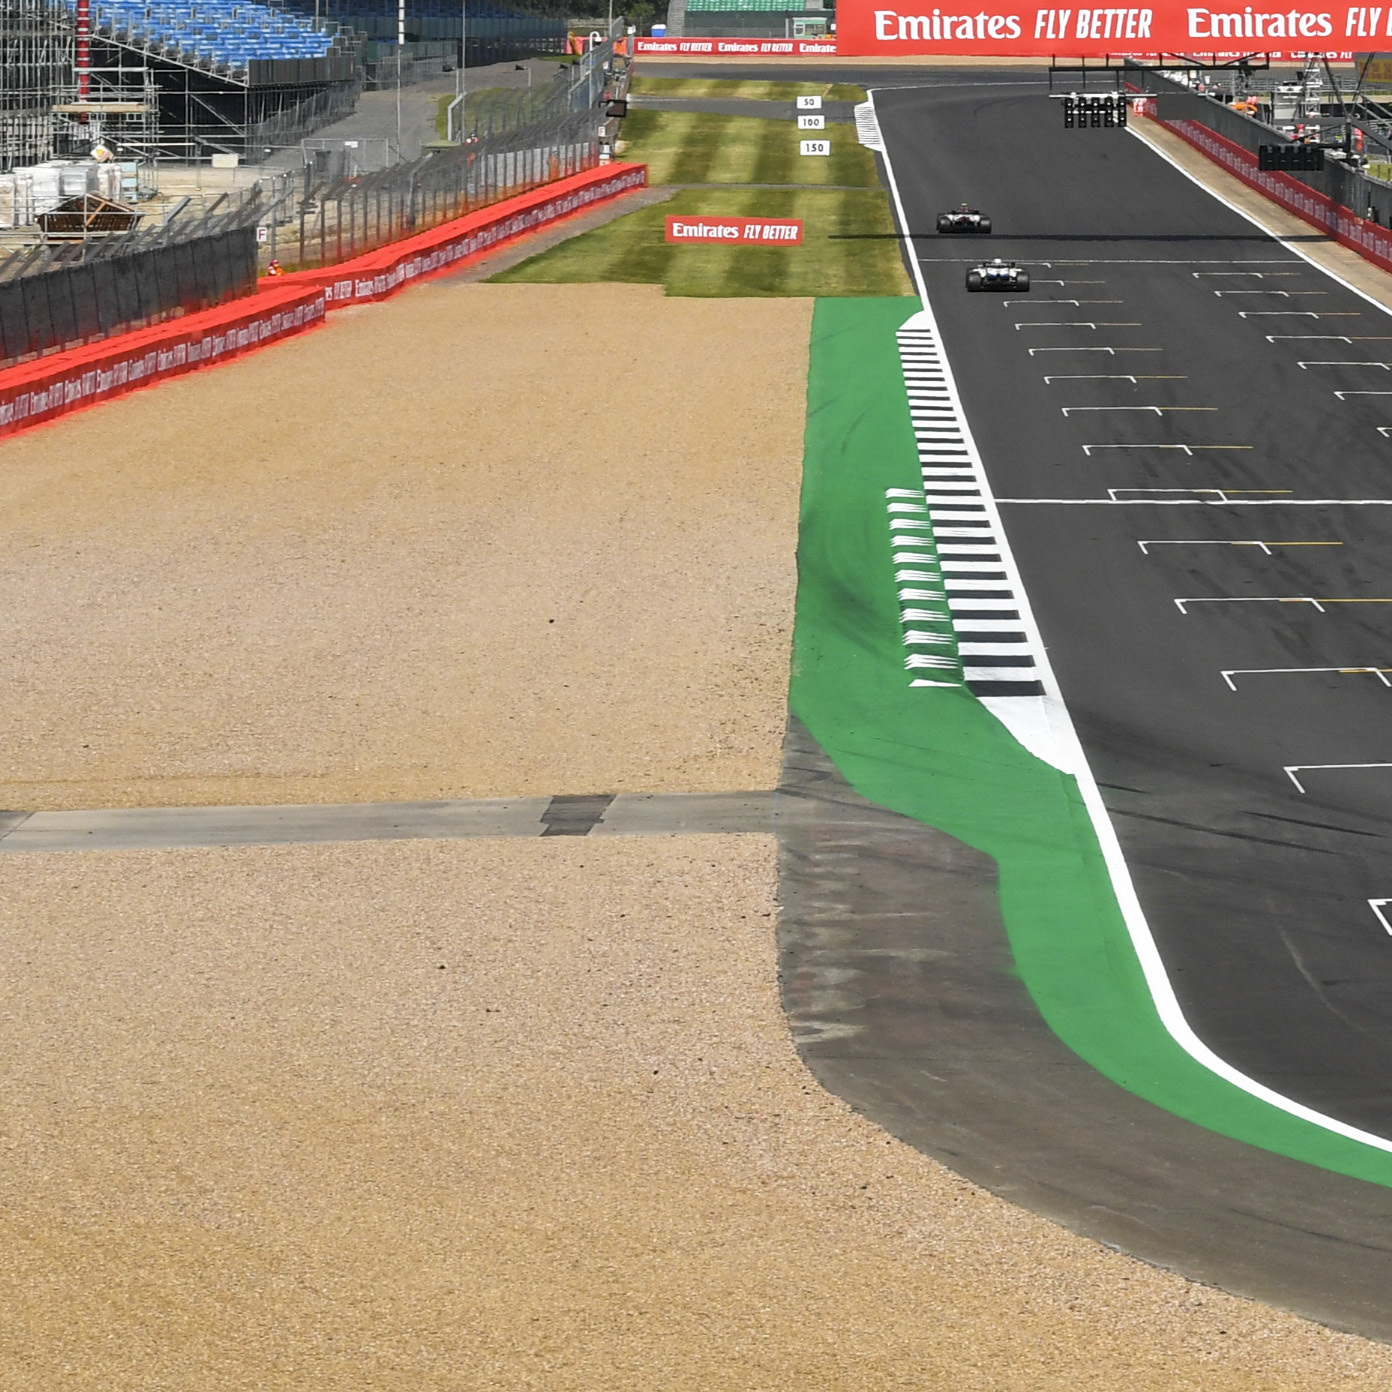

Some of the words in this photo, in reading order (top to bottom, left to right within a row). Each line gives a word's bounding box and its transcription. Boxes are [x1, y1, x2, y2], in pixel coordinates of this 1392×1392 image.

[874, 8, 1022, 41] Emirates
[1033, 8, 1072, 39] FLY
[1075, 8, 1153, 39] BETTER
[1186, 6, 1333, 38] Emirates
[1344, 6, 1384, 38] FLY
[637, 41, 678, 52] Emirates
[718, 42, 759, 53] Emirates
[799, 43, 837, 53] Emirate
[804, 98, 815, 106] 50
[802, 118, 820, 127] 100
[805, 143, 824, 153] 150
[258, 229, 266, 239] F
[672, 222, 739, 238] Emirates
[743, 224, 760, 240] FLY
[762, 224, 799, 240] BETTER
